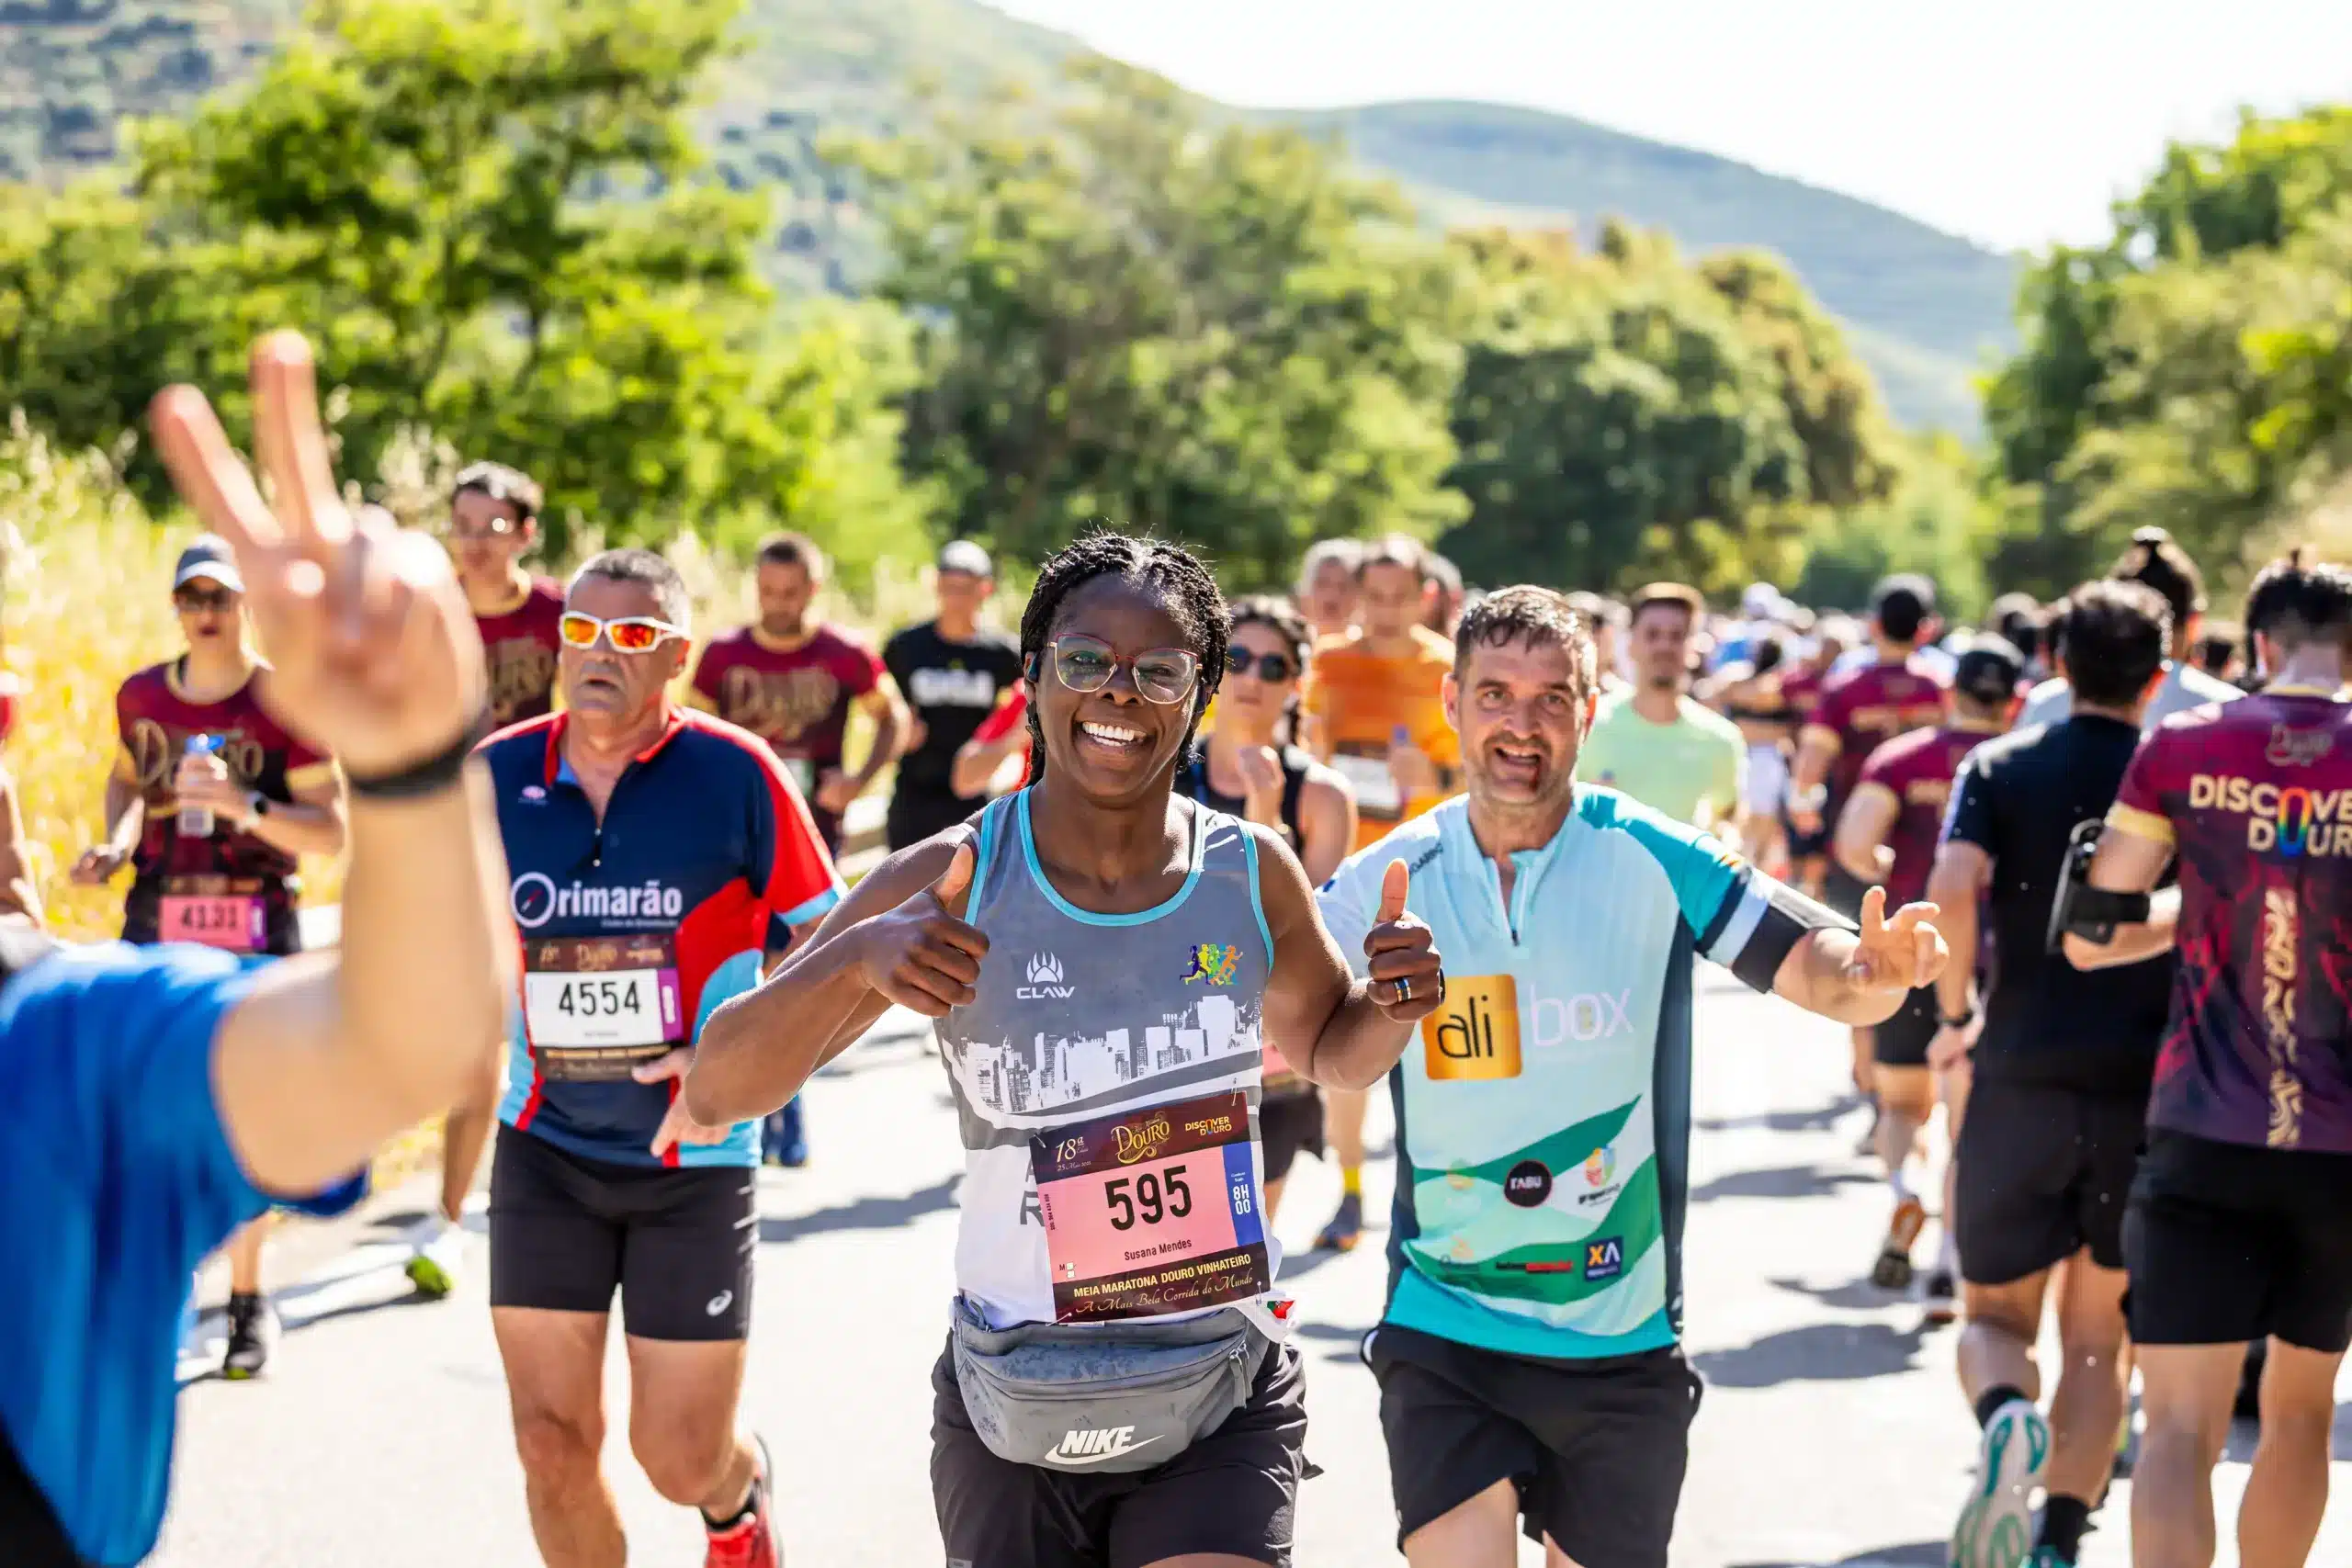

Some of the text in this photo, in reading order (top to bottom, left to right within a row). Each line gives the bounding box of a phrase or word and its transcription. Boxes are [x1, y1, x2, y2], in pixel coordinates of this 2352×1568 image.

[511, 871, 683, 929] Orimarão
[559, 978, 641, 1016] 4554
[1016, 986, 1075, 999] CLAW
[1437, 981, 1634, 1058] ali box
[1185, 1116, 1230, 1132] DISCOVER
[1200, 1122, 1232, 1135] DOURO
[1110, 1121, 1170, 1164] DOURO
[1104, 1165, 1192, 1231] 595
[1233, 1184, 1250, 1201] 8H
[1235, 1199, 1251, 1214] 00
[1125, 1239, 1193, 1261] Susana Mendes
[1073, 1254, 1250, 1298] MEIA MARATONA DOURO VINHATEIRO
[1076, 1267, 1253, 1314] A Mais Bela Corrida do Mundo
[1058, 1425, 1136, 1454] NIKE
